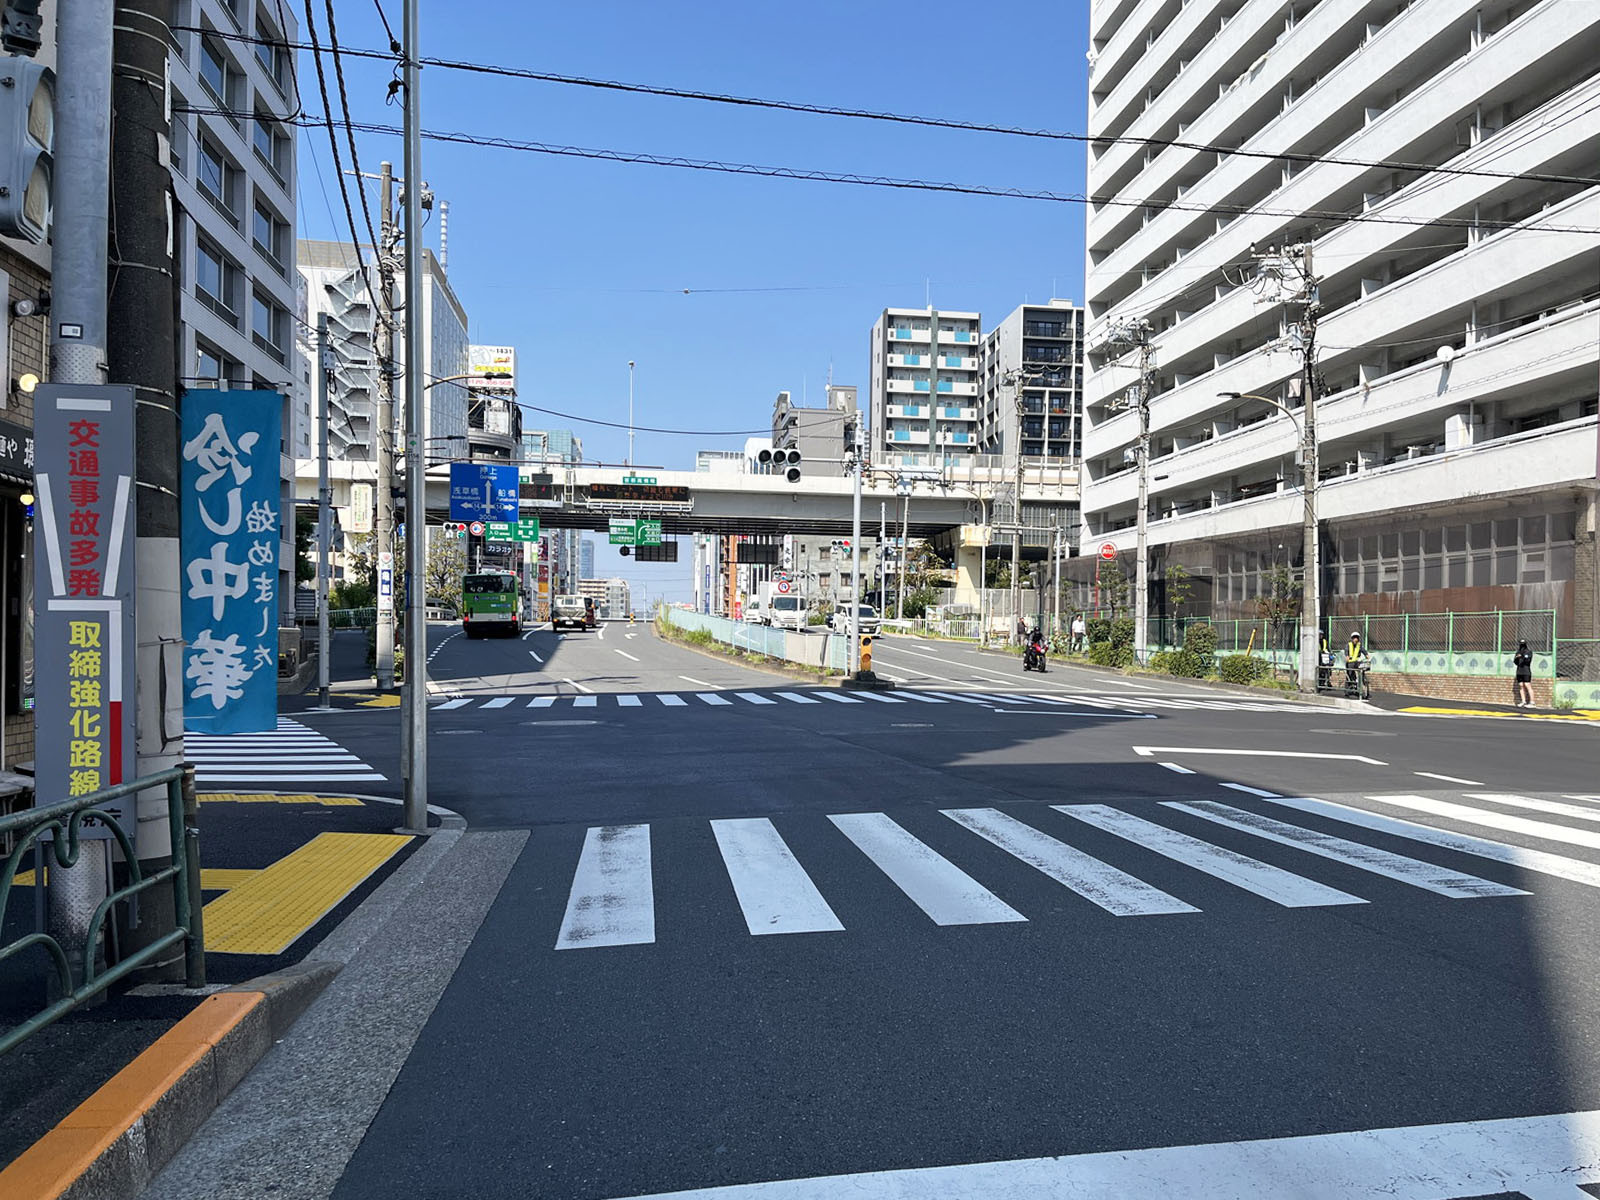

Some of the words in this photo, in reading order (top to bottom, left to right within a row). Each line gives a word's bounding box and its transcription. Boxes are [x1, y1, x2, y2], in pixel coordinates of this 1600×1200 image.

[68, 419, 100, 597] 交通事故多発
[68, 621, 102, 796] 取締強化路線
